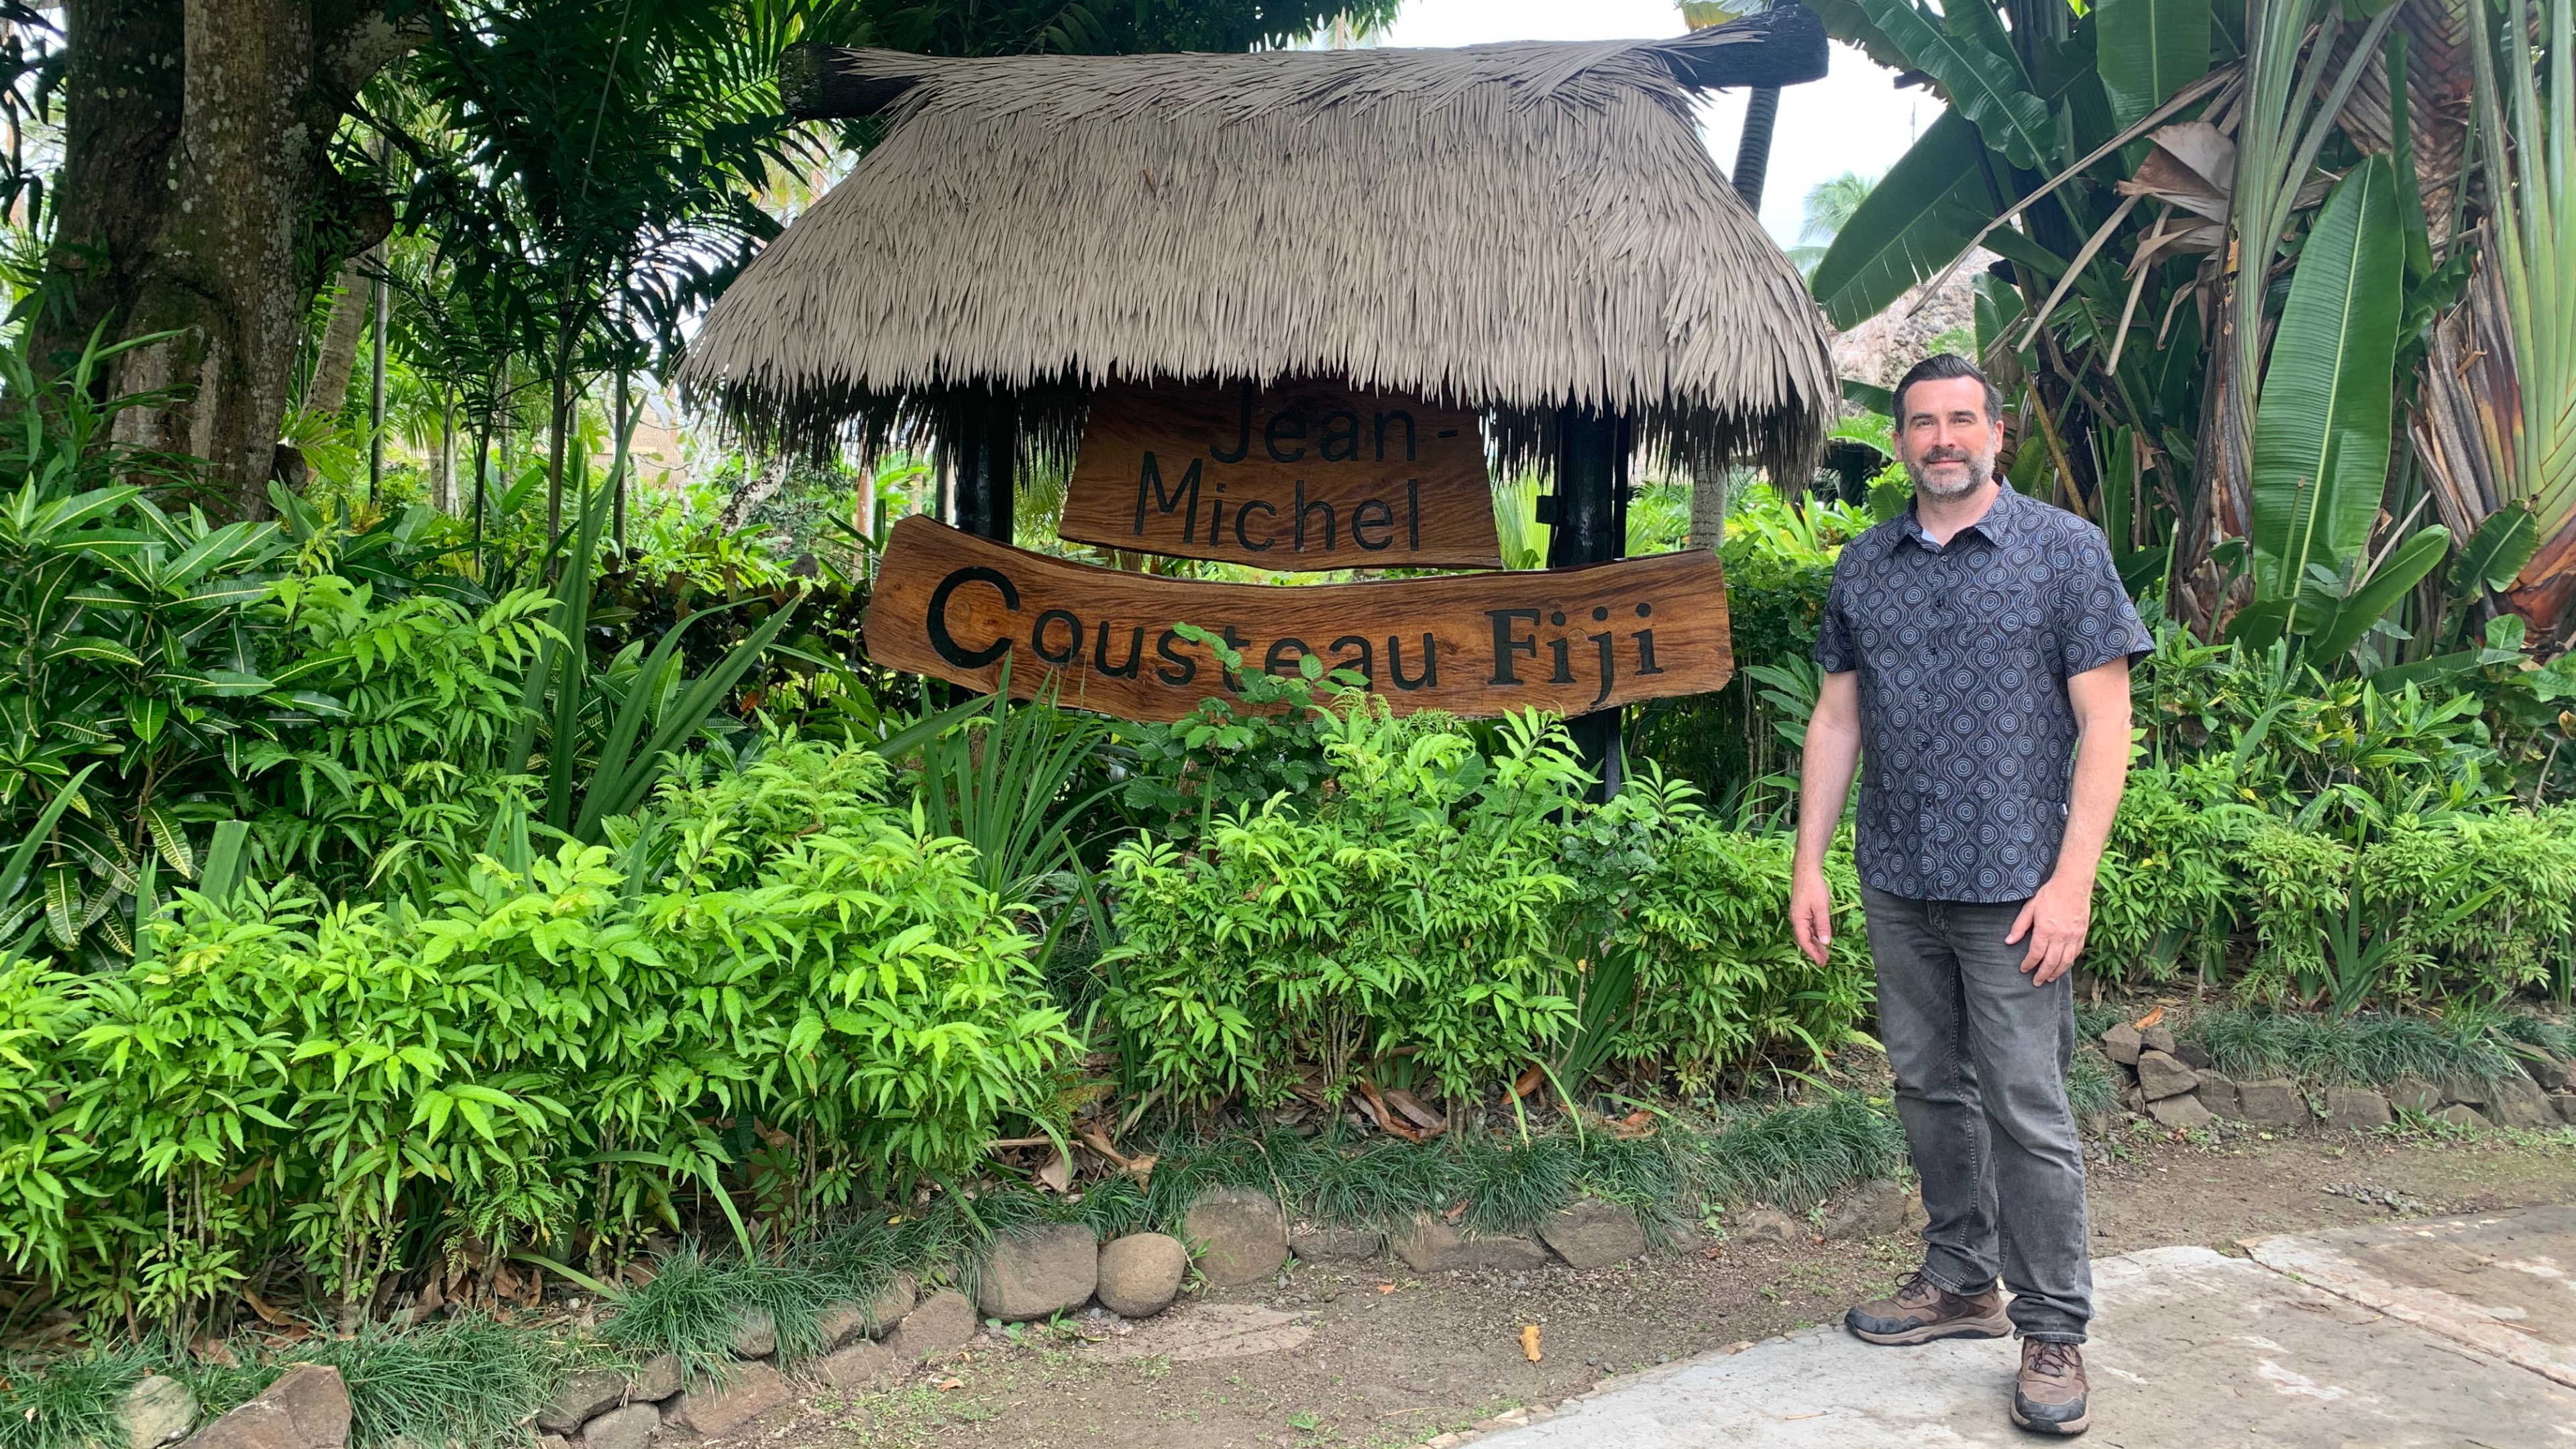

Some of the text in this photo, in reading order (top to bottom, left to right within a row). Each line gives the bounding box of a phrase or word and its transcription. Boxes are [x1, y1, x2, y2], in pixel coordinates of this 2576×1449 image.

[1134, 451, 1419, 551] Michel
[926, 566, 1664, 706] Cousteau Fiji
